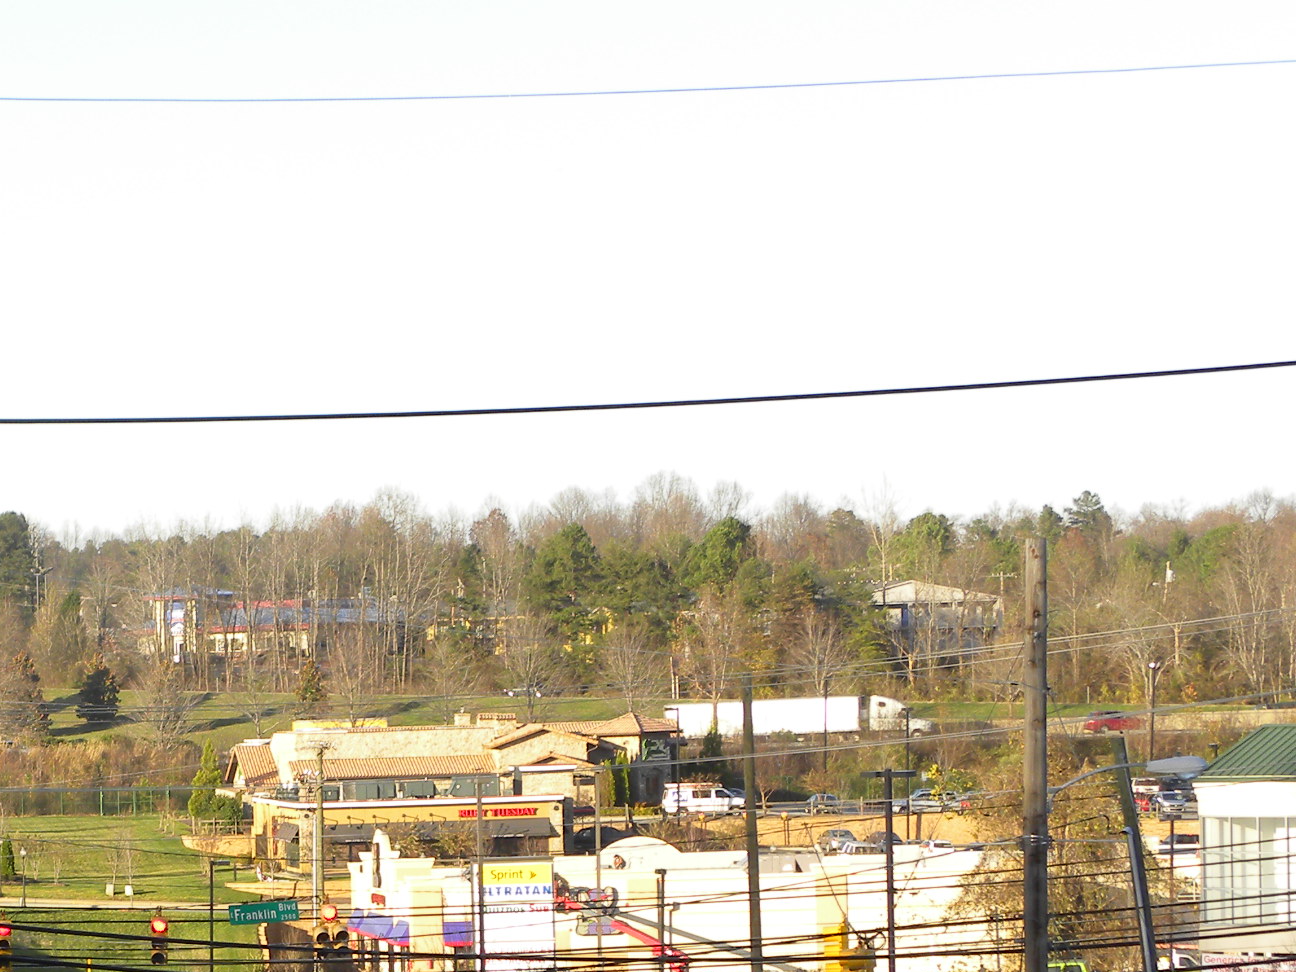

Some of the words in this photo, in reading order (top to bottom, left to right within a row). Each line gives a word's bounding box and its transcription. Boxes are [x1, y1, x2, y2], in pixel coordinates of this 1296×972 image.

[490, 807, 538, 817] TUESDAY
[490, 869, 524, 881] Sprint
[234, 908, 277, 921] Franklin
[278, 902, 296, 911] Blvd
